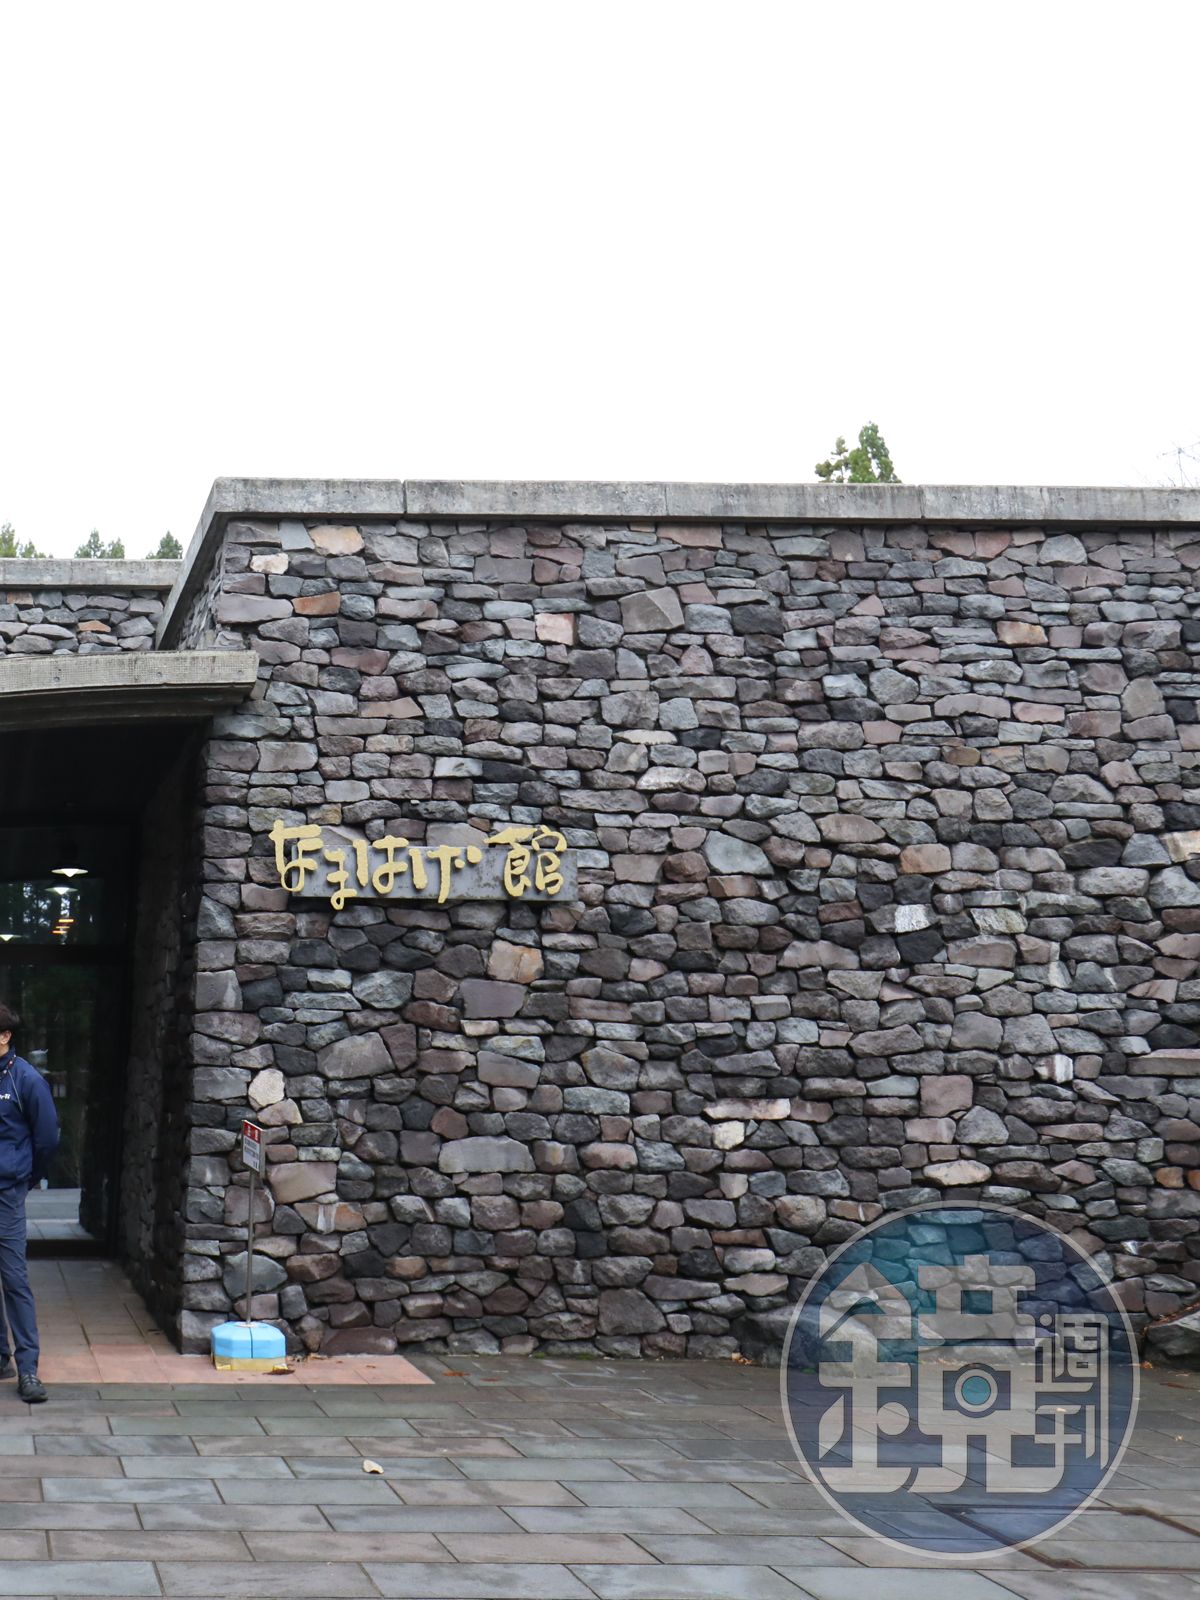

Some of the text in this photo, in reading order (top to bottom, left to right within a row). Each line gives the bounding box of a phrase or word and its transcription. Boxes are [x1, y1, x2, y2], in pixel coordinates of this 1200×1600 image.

[269, 819, 568, 910] なまはげ館
